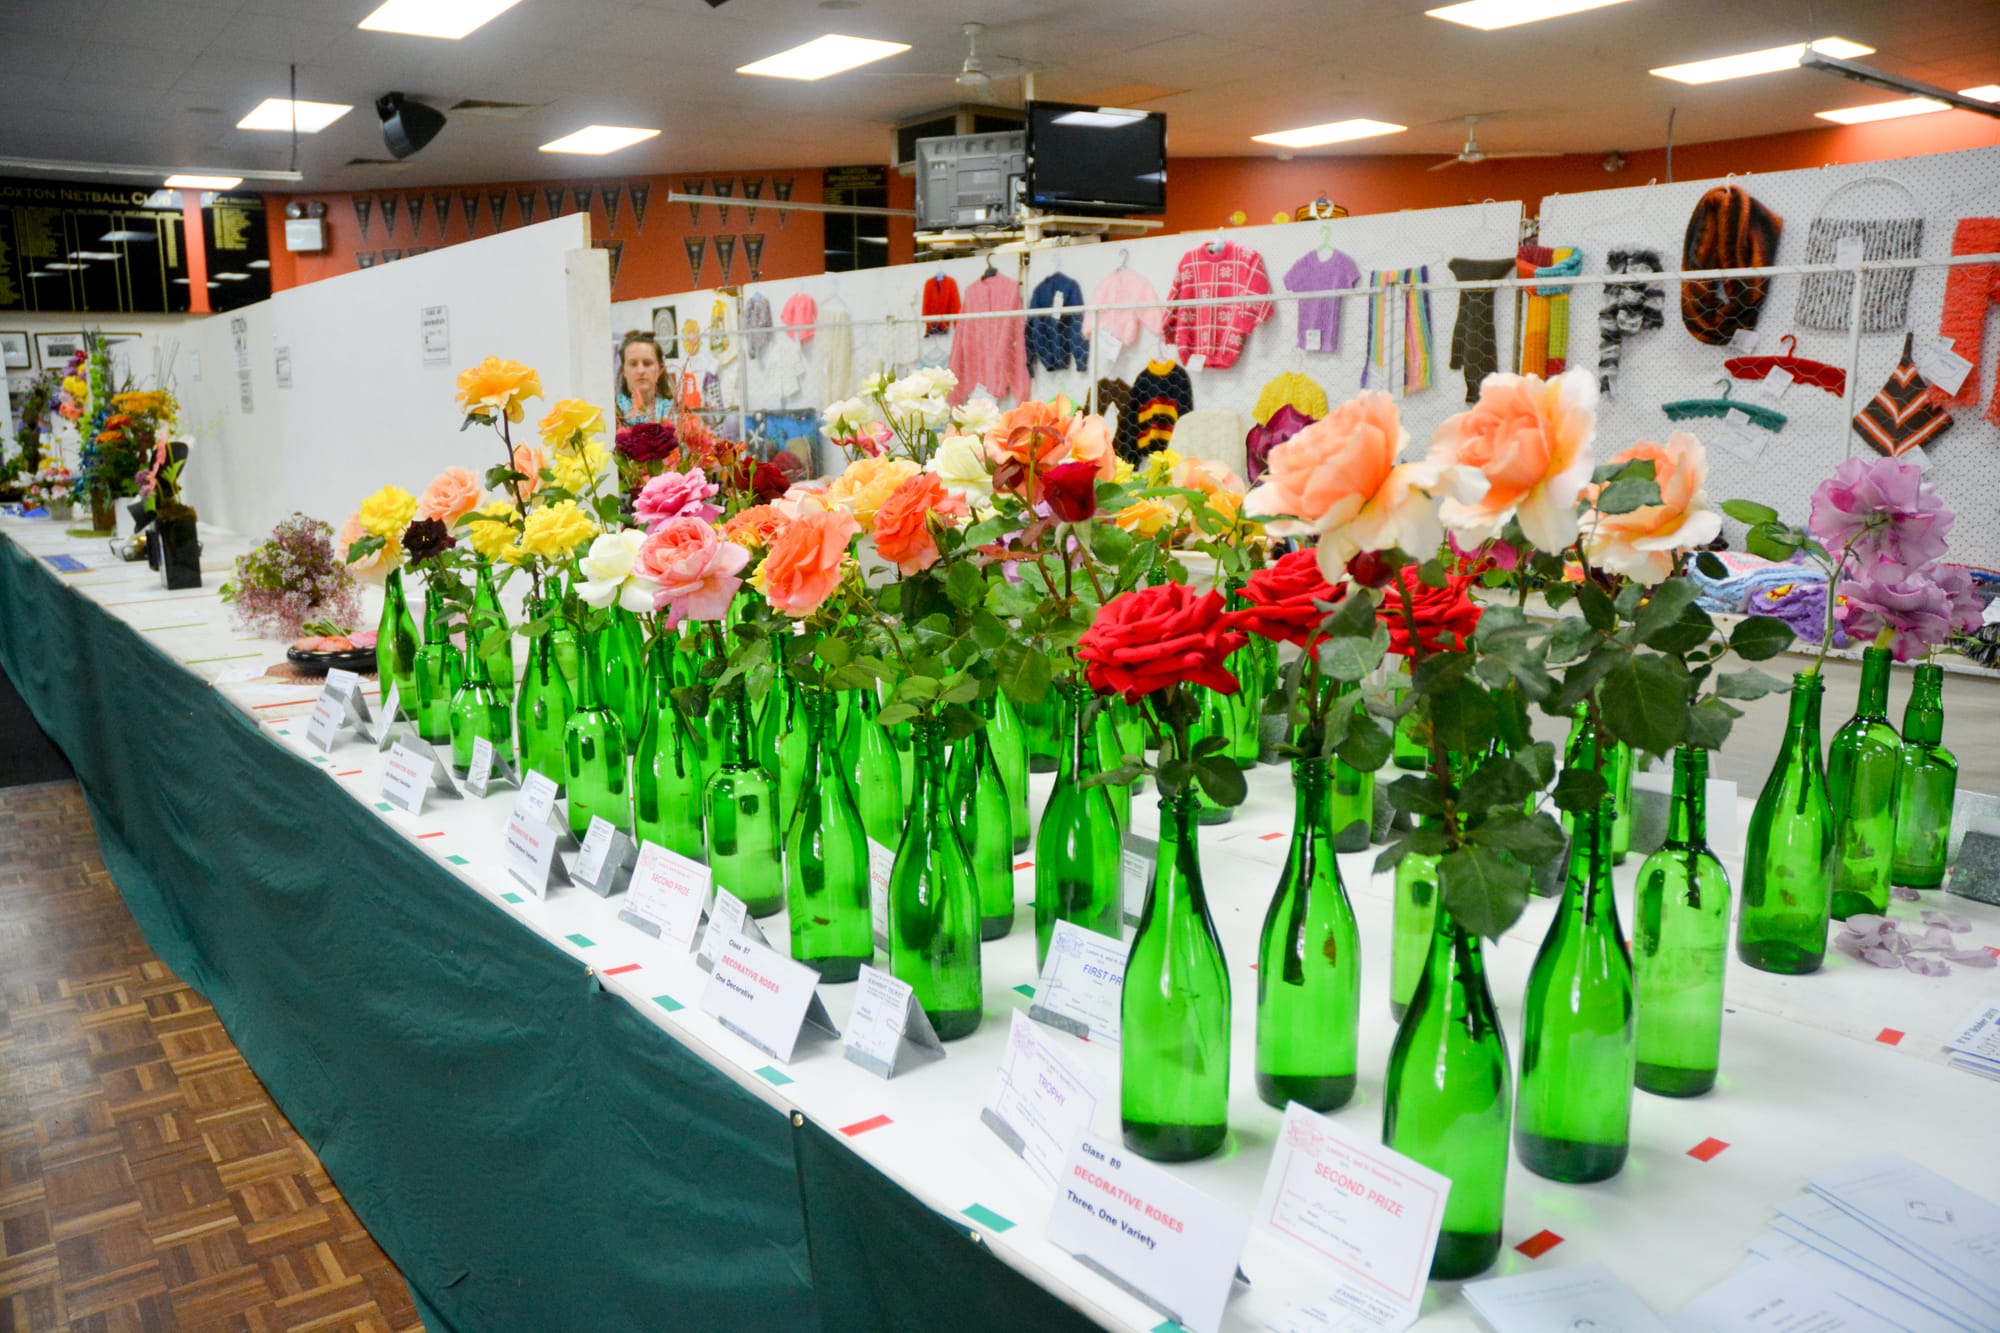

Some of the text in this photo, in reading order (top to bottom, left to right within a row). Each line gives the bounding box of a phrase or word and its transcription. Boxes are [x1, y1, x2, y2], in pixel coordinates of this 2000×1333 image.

[60, 188, 130, 204] NETBALL
[652, 872, 690, 897] SECOND PRIZE
[728, 938, 742, 951] Class
[715, 972, 754, 1001] One Decorative
[721, 955, 780, 993] DECORATIVE ROSES
[1082, 964, 1109, 980] FIRST
[1038, 1072, 1066, 1106] TROPHY
[1081, 1142, 1122, 1170] Class 89
[1073, 1164, 1184, 1233] DECORATIVE ROSES
[1314, 1161, 1406, 1217] SECOND PRIZE
[1067, 1189, 1157, 1250] Three, One Variety
